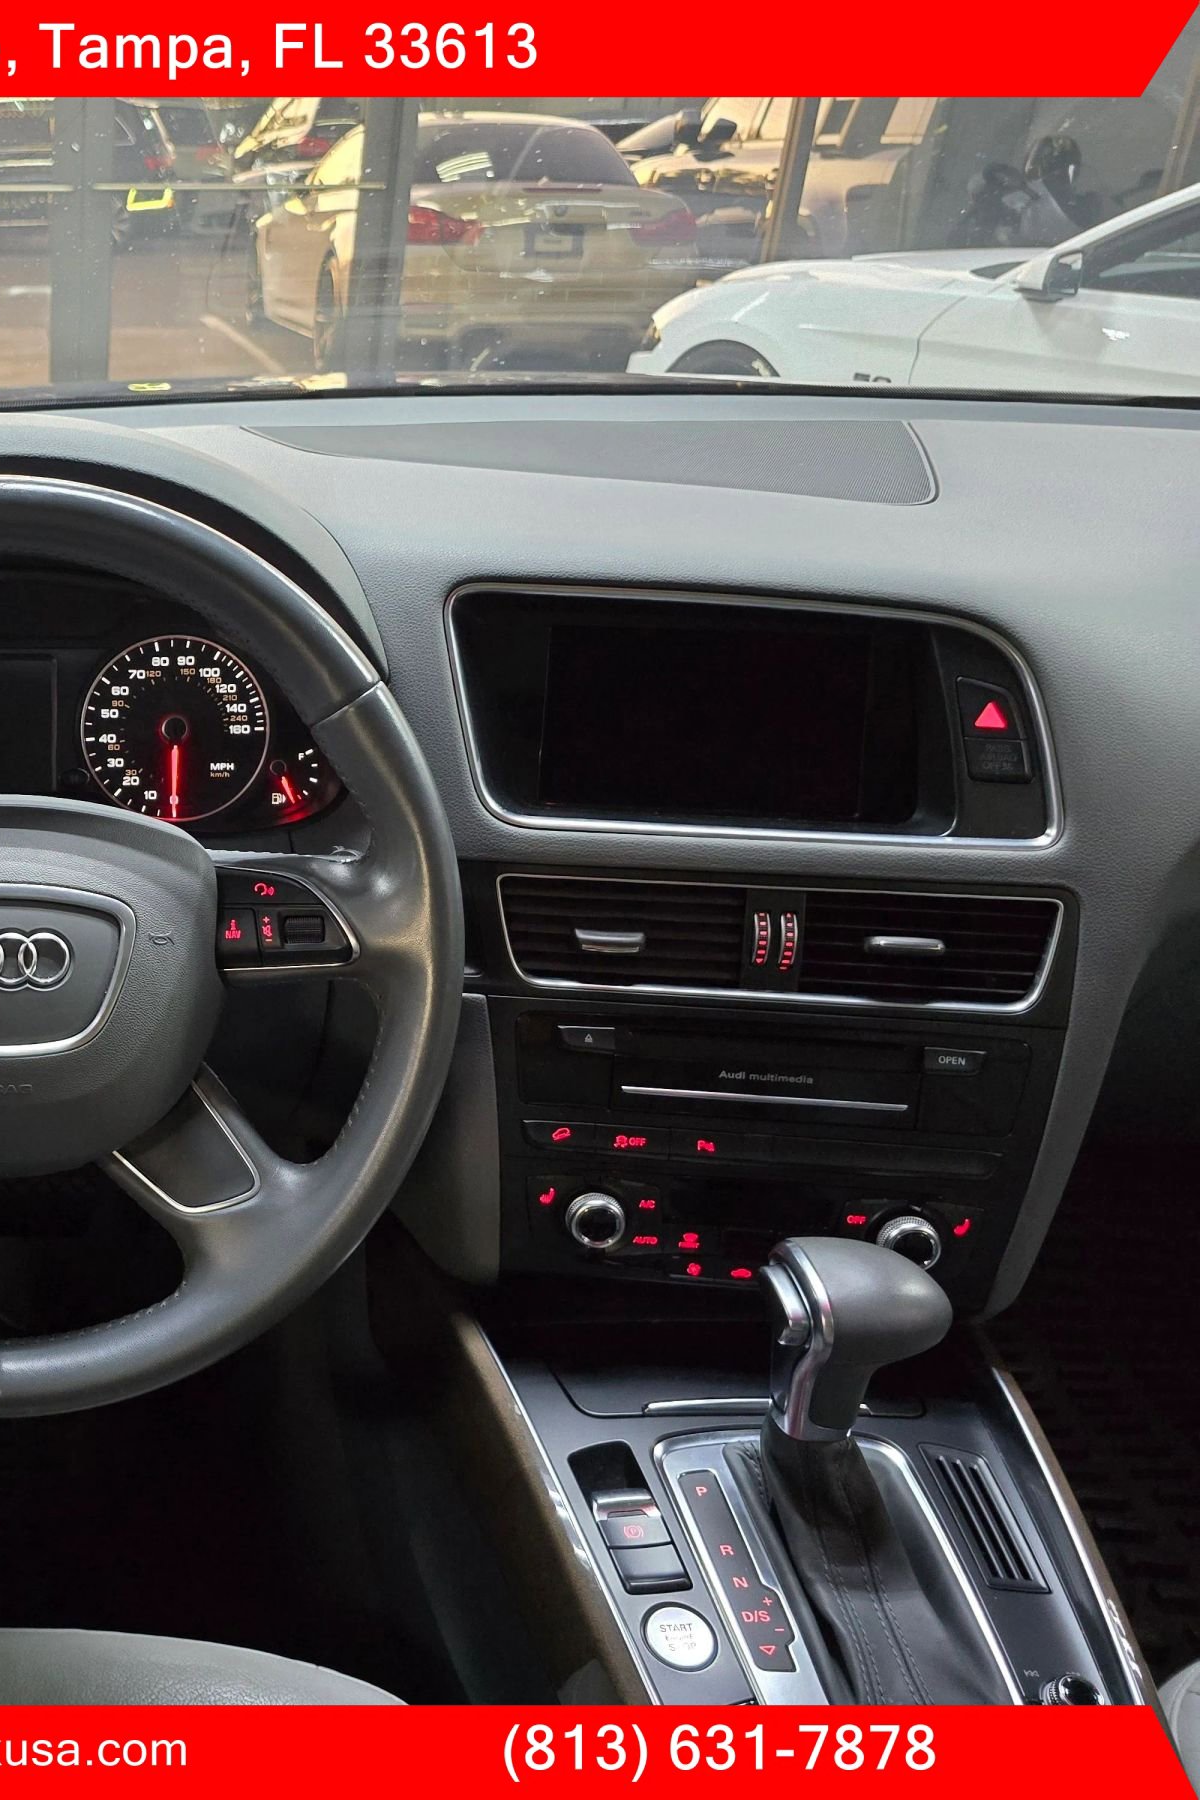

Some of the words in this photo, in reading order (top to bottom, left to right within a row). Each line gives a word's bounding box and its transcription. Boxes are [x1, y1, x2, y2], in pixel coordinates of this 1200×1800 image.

[151, 656, 169, 666] 80
[177, 656, 195, 666] 90
[128, 669, 145, 679] 70
[199, 668, 220, 678] 100
[111, 686, 129, 696] 60
[215, 684, 236, 693] 120
[226, 703, 247, 713] 140
[101, 709, 119, 719] 50
[229, 725, 251, 734] 160
[99, 734, 116, 743] 40
[107, 758, 124, 768] 30
[210, 763, 234, 771] MPH
[123, 776, 140, 786] 20
[144, 791, 157, 800] 10
[225, 930, 241, 939] NAV
[938, 1055, 966, 1066] OPEN
[718, 1070, 746, 1080] Audi
[749, 1073, 813, 1084] multimedia
[628, 1137, 646, 1147] OFF
[632, 1236, 658, 1245] AUTO
[696, 1486, 708, 1496] P
[720, 1545, 734, 1556] R
[732, 1576, 749, 1588] N
[741, 1610, 771, 1623] D/S
[659, 1622, 693, 1633] START
